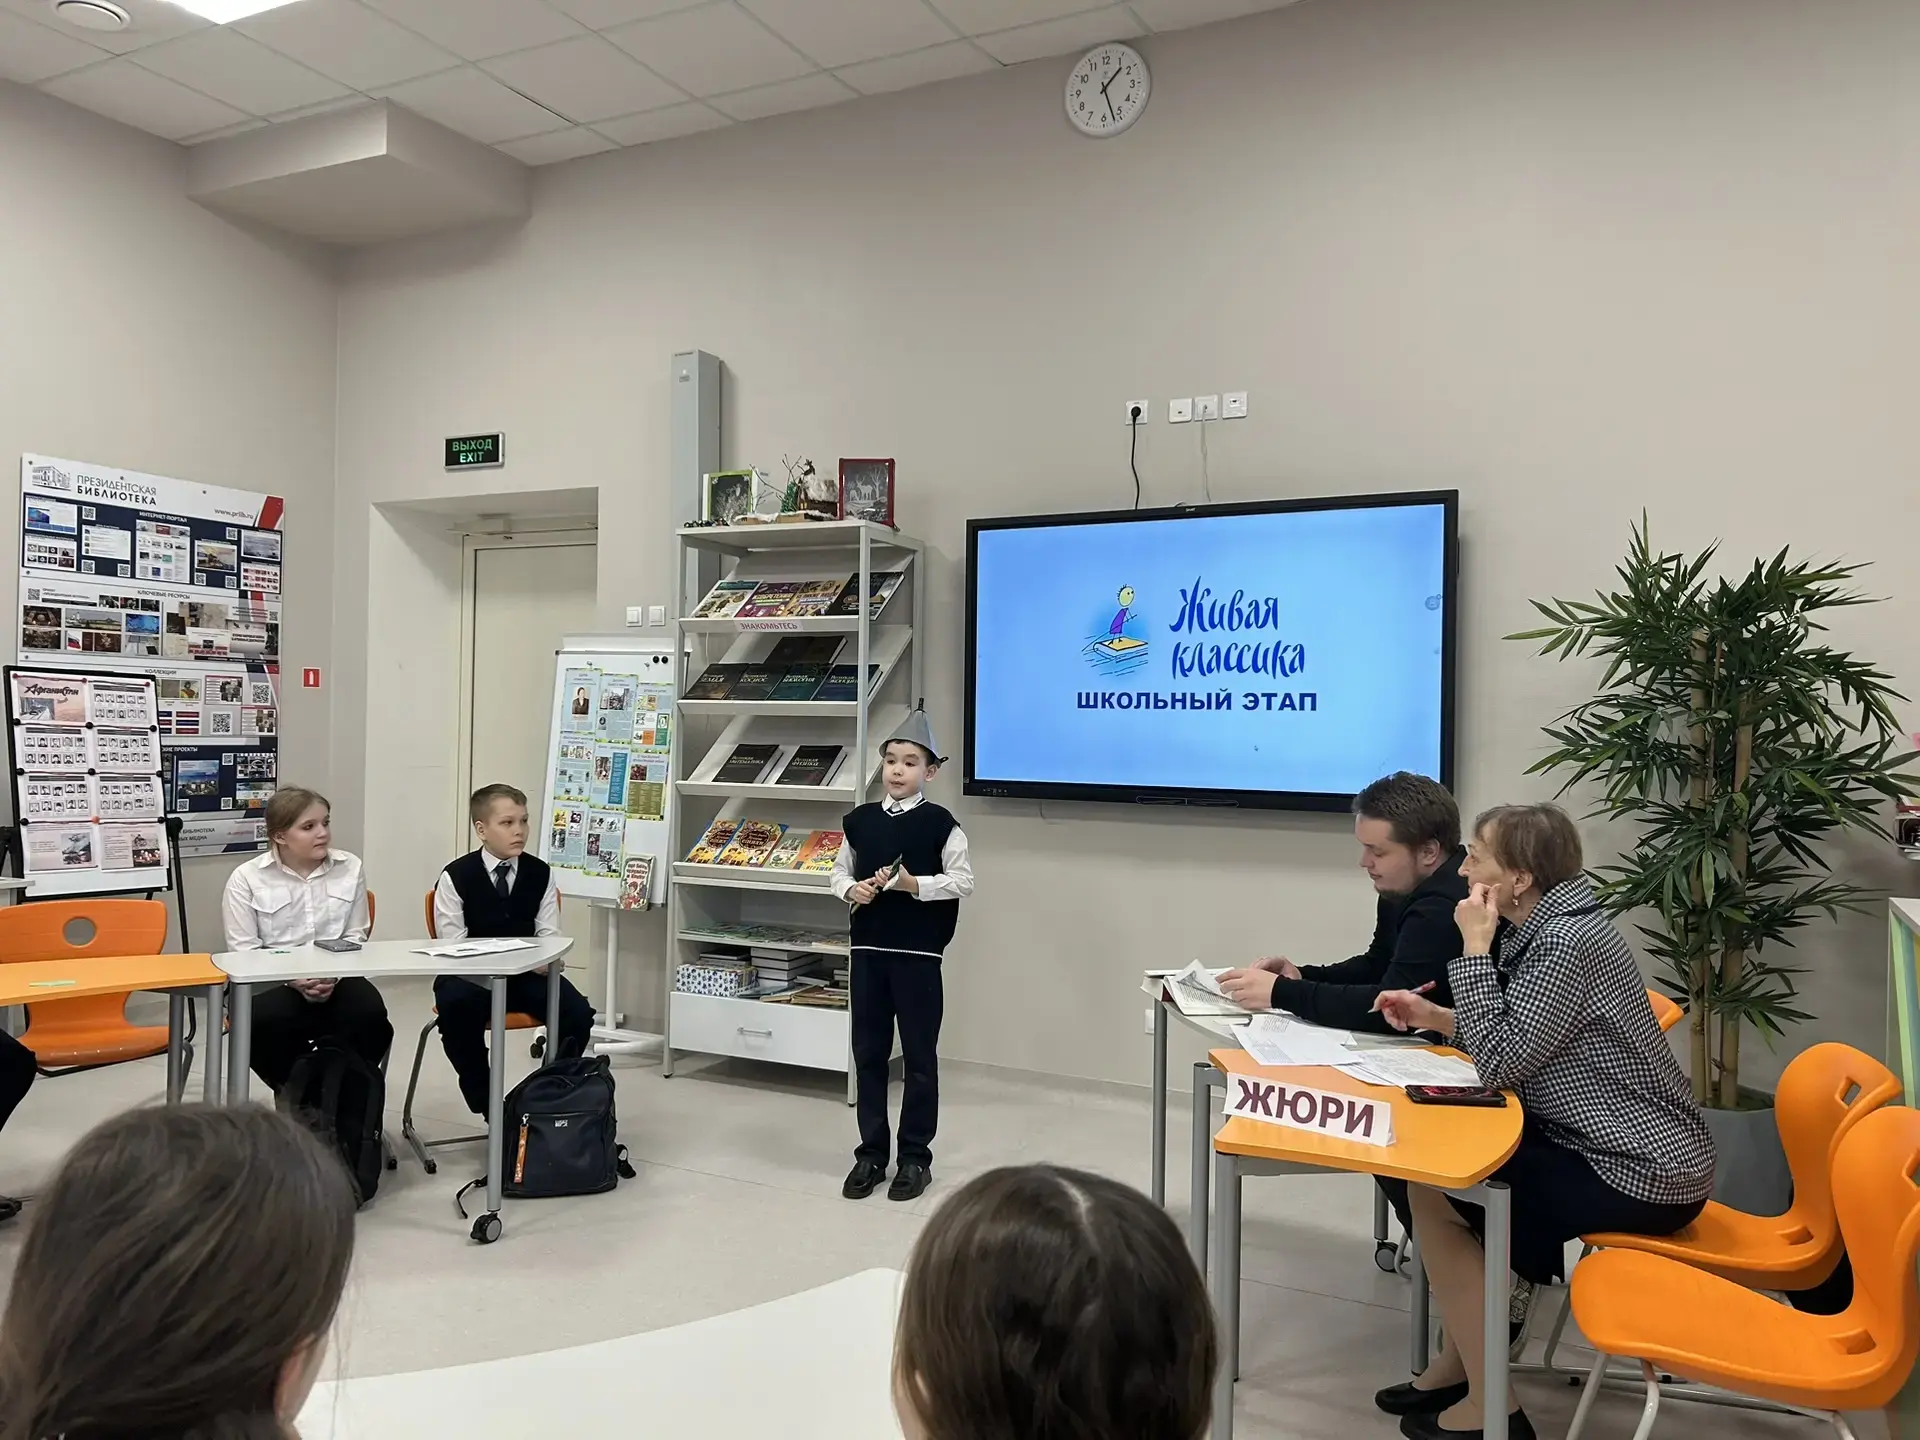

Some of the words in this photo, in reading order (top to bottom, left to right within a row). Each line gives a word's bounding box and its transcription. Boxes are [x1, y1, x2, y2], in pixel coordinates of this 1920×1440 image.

[1102, 56, 1111, 65] 12
[1118, 57, 1122, 66] 1
[1089, 62, 1097, 71] 11
[1126, 66, 1131, 75] 2
[1080, 74, 1089, 84] 10
[1129, 79, 1135, 88] 3
[1075, 89, 1081, 99] 9
[1124, 94, 1131, 102] 4
[1079, 101, 1085, 111] 8
[1116, 106, 1122, 116] 5
[1088, 111, 1094, 121] 7
[1101, 113, 1107, 122] 6
[452, 439, 492, 451] ВЫХОД
[460, 451, 484, 463] EXIT
[77, 475, 157, 496] ПРЕЗИДЕНТСКАЯ
[77, 485, 157, 506] БИБЛИОТЕКА
[1169, 576, 1278, 633] Живая
[740, 622, 798, 630] ЗНАКОМЬТЕСЬ
[1172, 641, 1305, 680] классика
[144, 668, 177, 676] КОЛЛЕКЦИИ
[1077, 688, 1232, 711] ШКОЛЬНЫЙ
[1242, 692, 1317, 712] ЭТАП
[1235, 1079, 1375, 1138] ЖЮРИ
